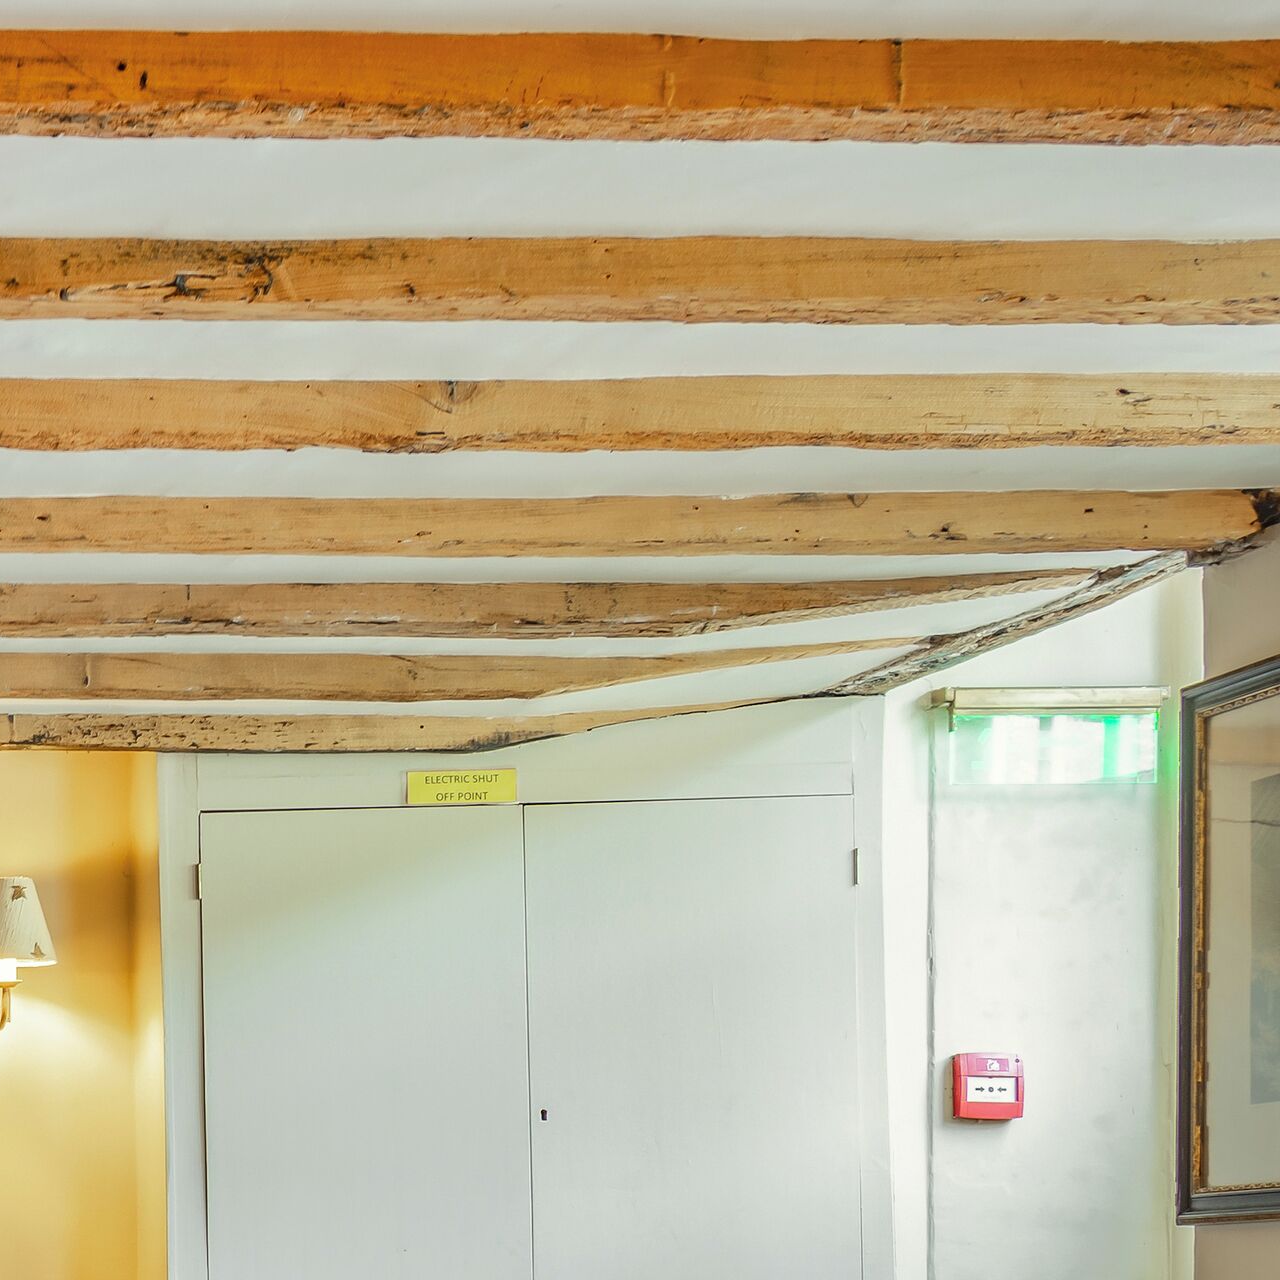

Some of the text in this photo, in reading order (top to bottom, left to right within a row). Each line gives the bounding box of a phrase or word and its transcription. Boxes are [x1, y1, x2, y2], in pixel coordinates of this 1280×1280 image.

[425, 774, 499, 784] ELECTRIC SHUT
[436, 792, 488, 801] OFF POINT
